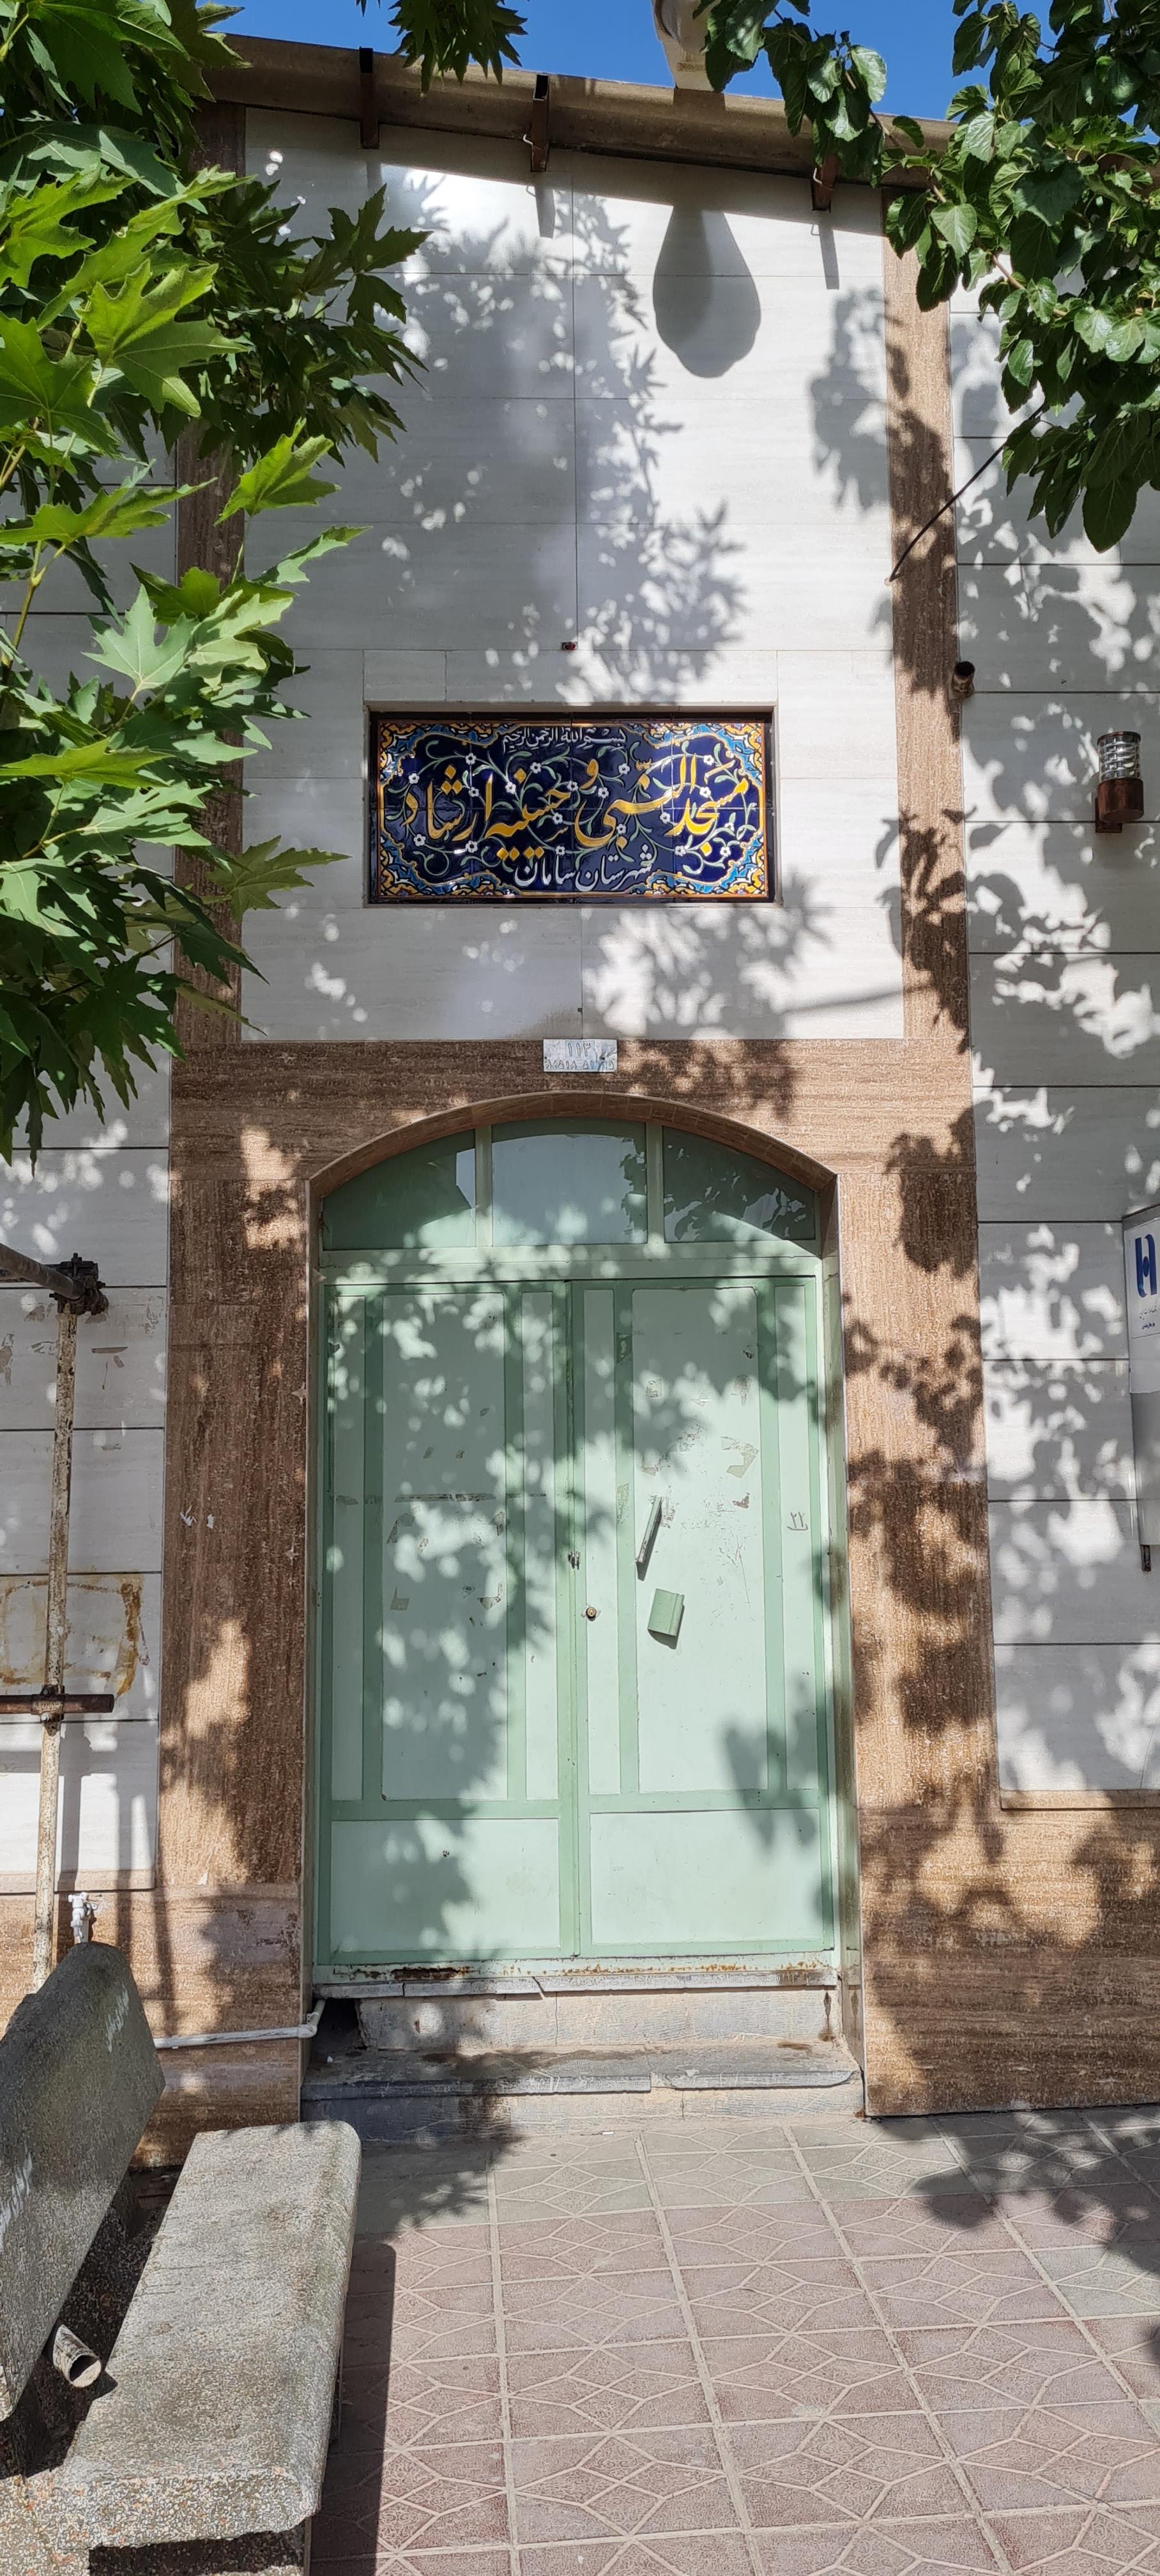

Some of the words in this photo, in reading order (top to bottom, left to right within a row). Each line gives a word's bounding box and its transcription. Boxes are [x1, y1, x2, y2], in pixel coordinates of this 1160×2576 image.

[400, 764, 493, 841] ارشاد
[579, 758, 599, 790] و
[485, 768, 571, 861] حسینیه
[664, 760, 749, 857] مسجد
[514, 855, 576, 887] سامان
[575, 843, 652, 892] شهرستان
